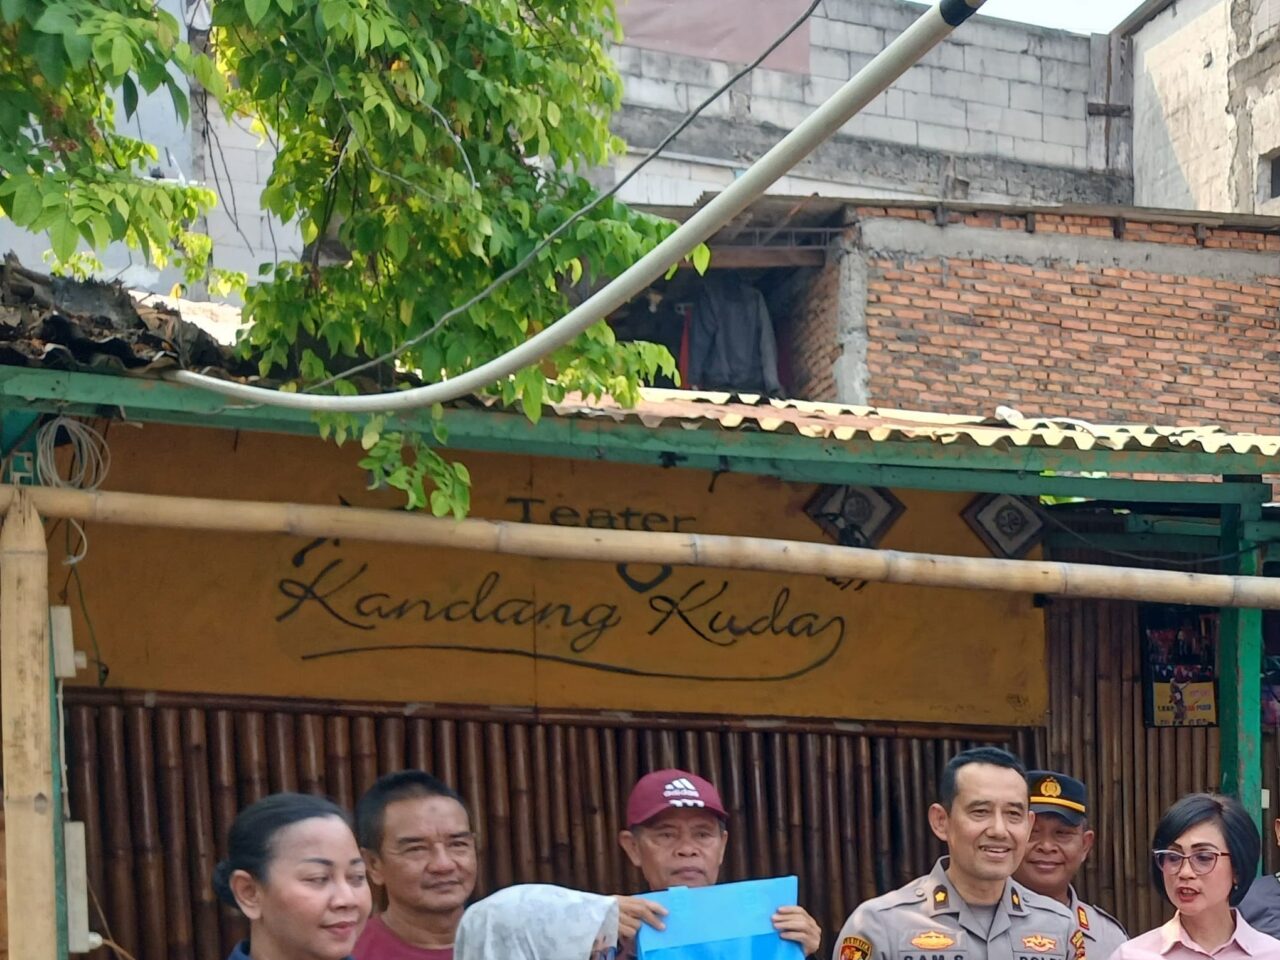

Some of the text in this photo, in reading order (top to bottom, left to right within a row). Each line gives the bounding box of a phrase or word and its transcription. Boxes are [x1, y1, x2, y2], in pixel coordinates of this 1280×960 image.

[506, 497, 697, 533] Teater
[276, 558, 844, 653] Kandang Kuda
